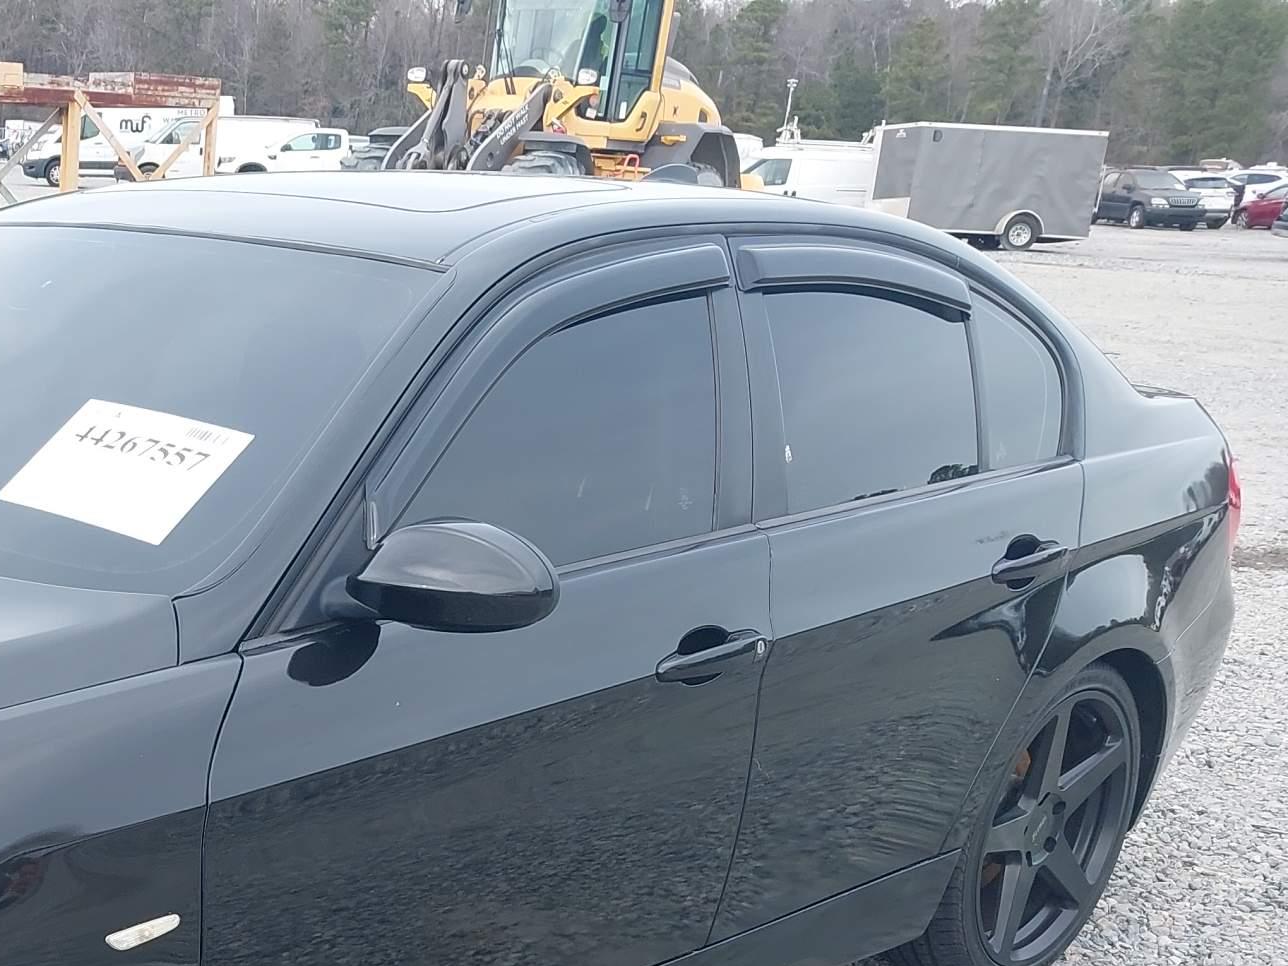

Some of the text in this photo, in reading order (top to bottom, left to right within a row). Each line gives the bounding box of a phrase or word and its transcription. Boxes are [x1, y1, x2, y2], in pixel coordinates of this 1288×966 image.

[500, 114, 529, 145] UNDER MAST
[504, 117, 516, 131] NOT
[515, 104, 529, 120] WALK
[75, 425, 211, 471] 44267557
